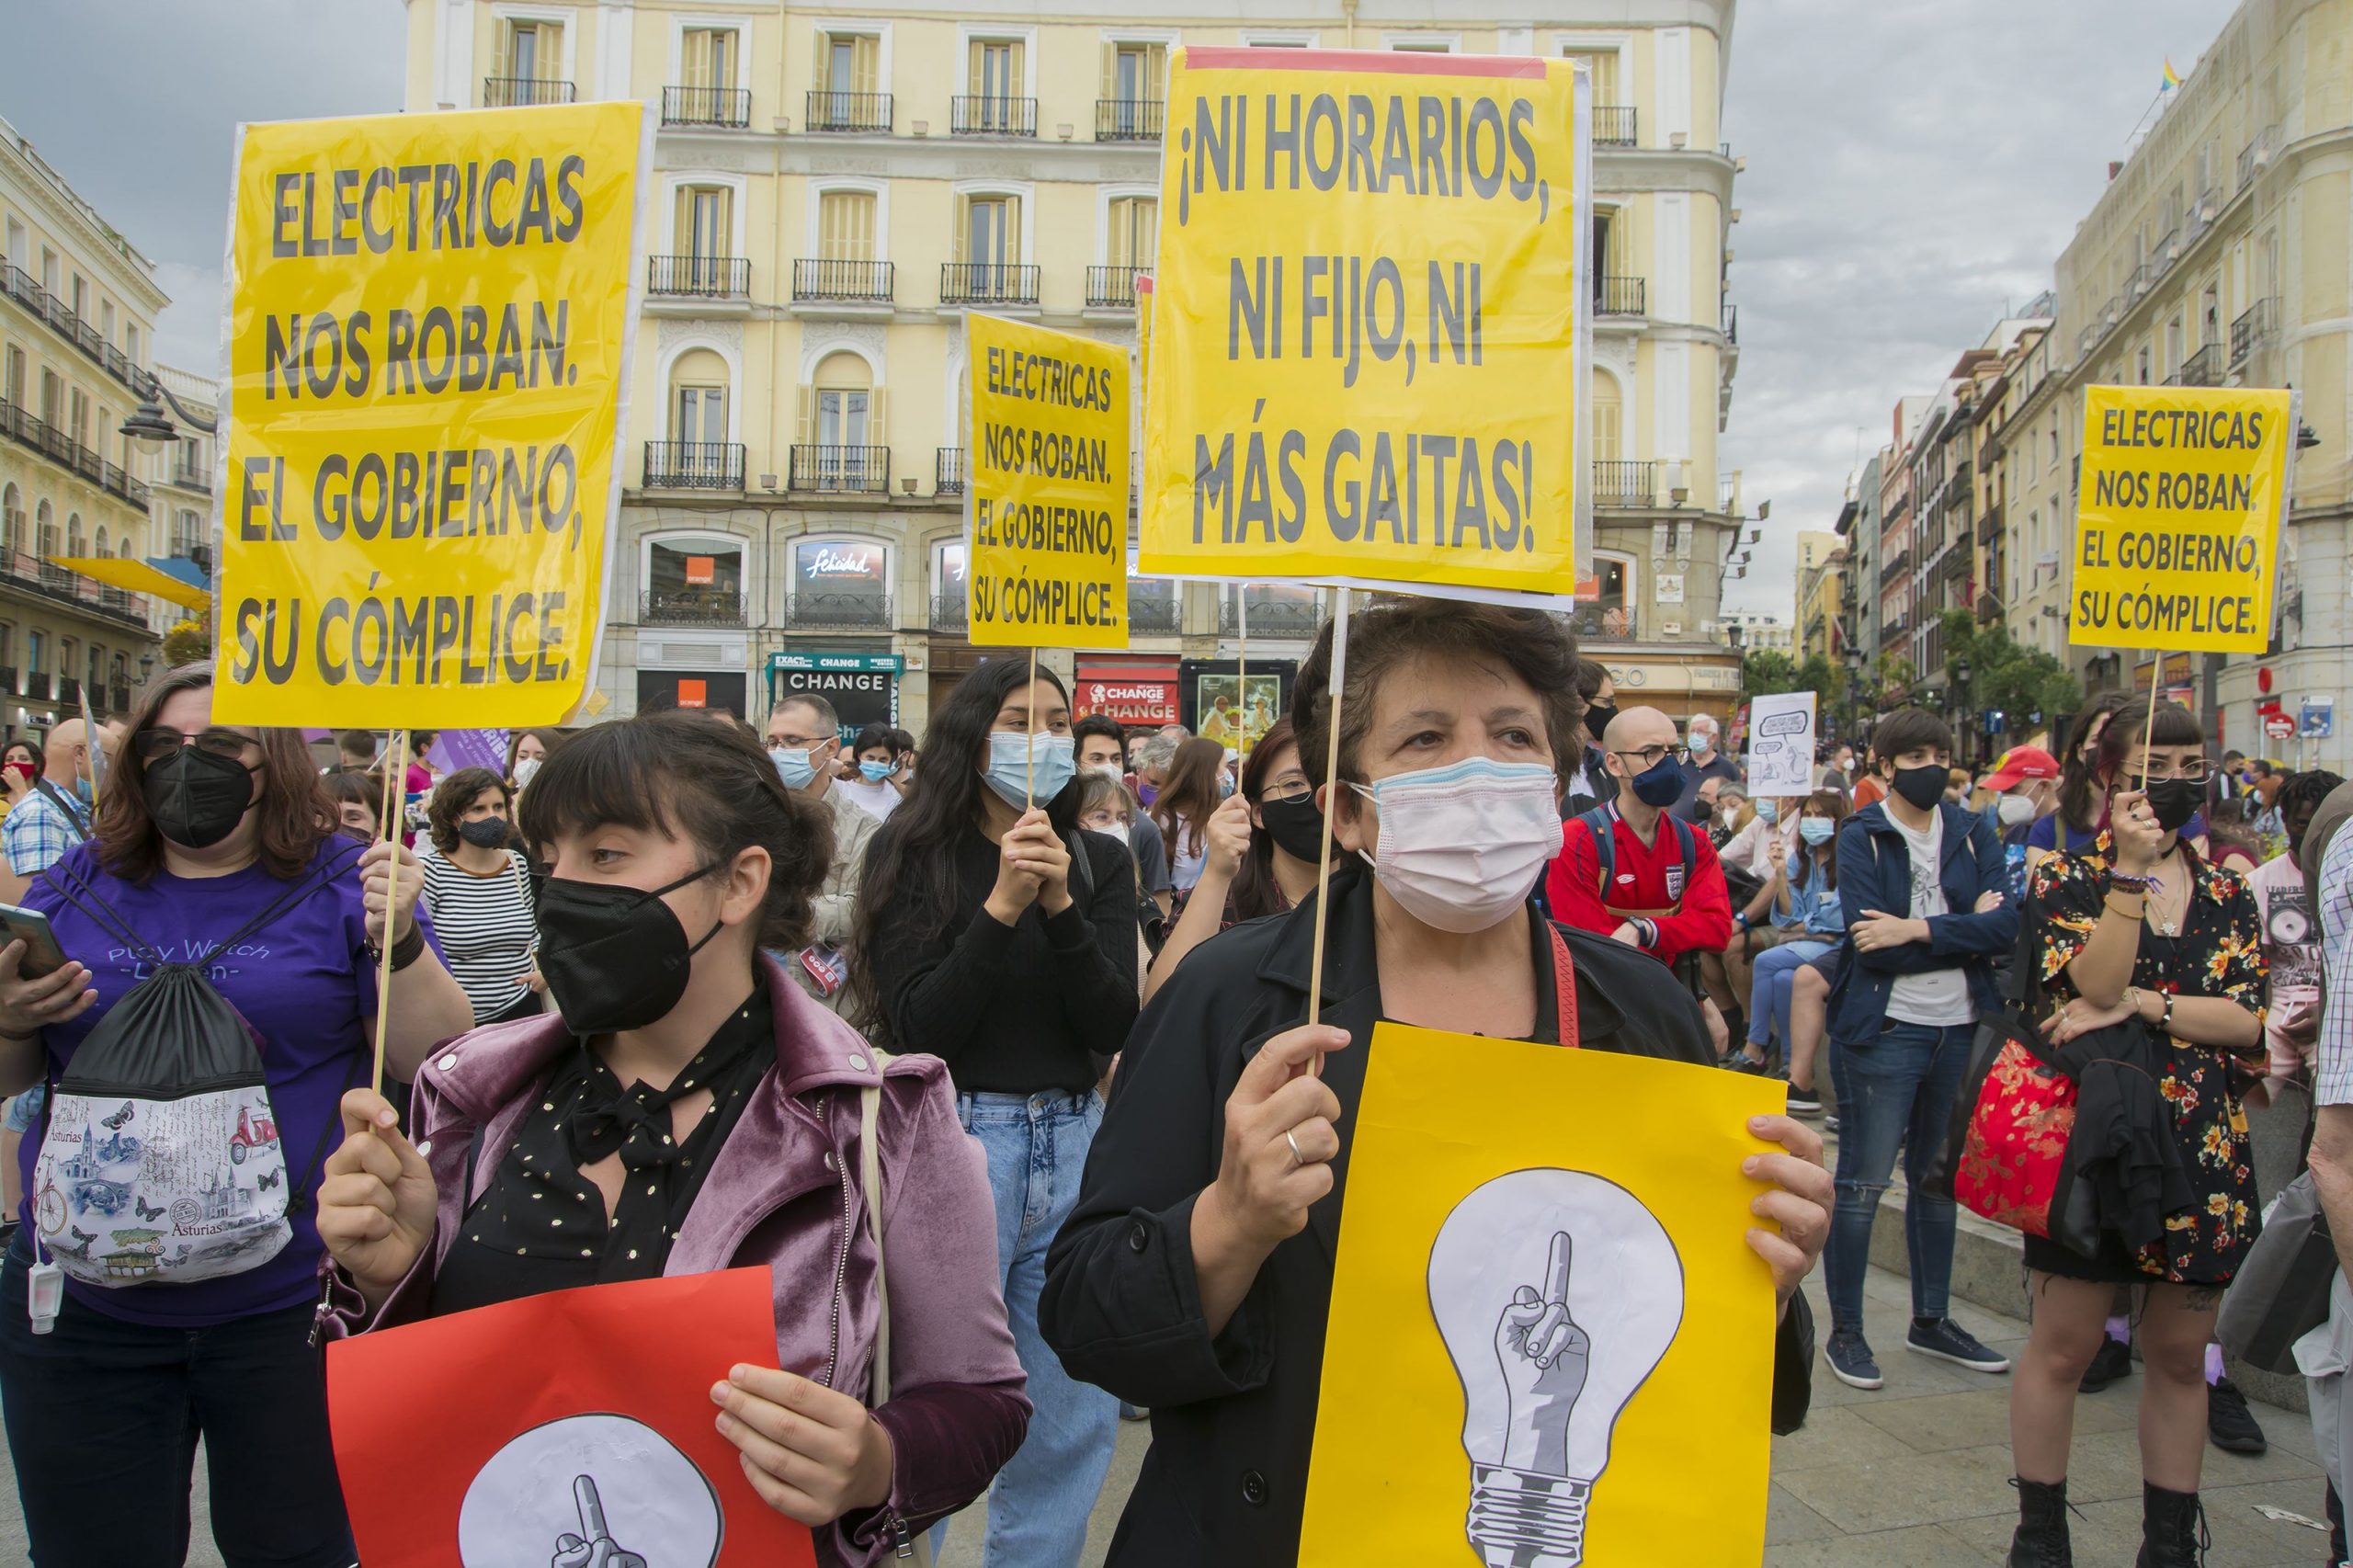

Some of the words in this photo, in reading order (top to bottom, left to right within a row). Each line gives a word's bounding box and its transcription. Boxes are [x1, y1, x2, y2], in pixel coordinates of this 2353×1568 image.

[1179, 95, 1246, 225] ¡NI
[1264, 93, 1549, 223] HORARIOS,
[272, 154, 584, 257] ELECTRICAS
[265, 310, 370, 400] NOS
[386, 300, 576, 395] ROBAN.
[1228, 256, 1282, 359] NI
[1302, 256, 1415, 388] FIJO,
[1428, 260, 1482, 365] NI
[987, 346, 1110, 412] ELECTRICAS
[984, 421, 1026, 473] NOS
[1029, 429, 1110, 484] ROBAN.
[2102, 409, 2262, 449] ELECTRICAS
[240, 456, 297, 541] EL
[313, 443, 581, 550] GOBIERNO,
[1192, 398, 1306, 543] MÁS
[1323, 428, 1533, 552] GAITAS!
[2096, 470, 2148, 508] NOS
[2155, 472, 2256, 511] ROBAN.
[977, 497, 996, 546] EL
[1002, 501, 1116, 564] GOBIERNO,
[2083, 529, 2109, 567] EL
[2117, 531, 2260, 579] GOBIERNO,
[974, 574, 995, 622] SU
[1001, 563, 1117, 626] CÓMPLICE.
[2078, 590, 2109, 628] SU
[2116, 582, 2256, 633] CÓMPLICE.
[233, 597, 300, 685] SU
[315, 571, 569, 686] CÓMPLICE.
[790, 673, 883, 690] CHANGE
[820, 658, 860, 667] CHANGE
[1107, 688, 1165, 699] CHANGE
[1091, 704, 1176, 719] CHANGE
[172, 1222, 222, 1236] Asturias
